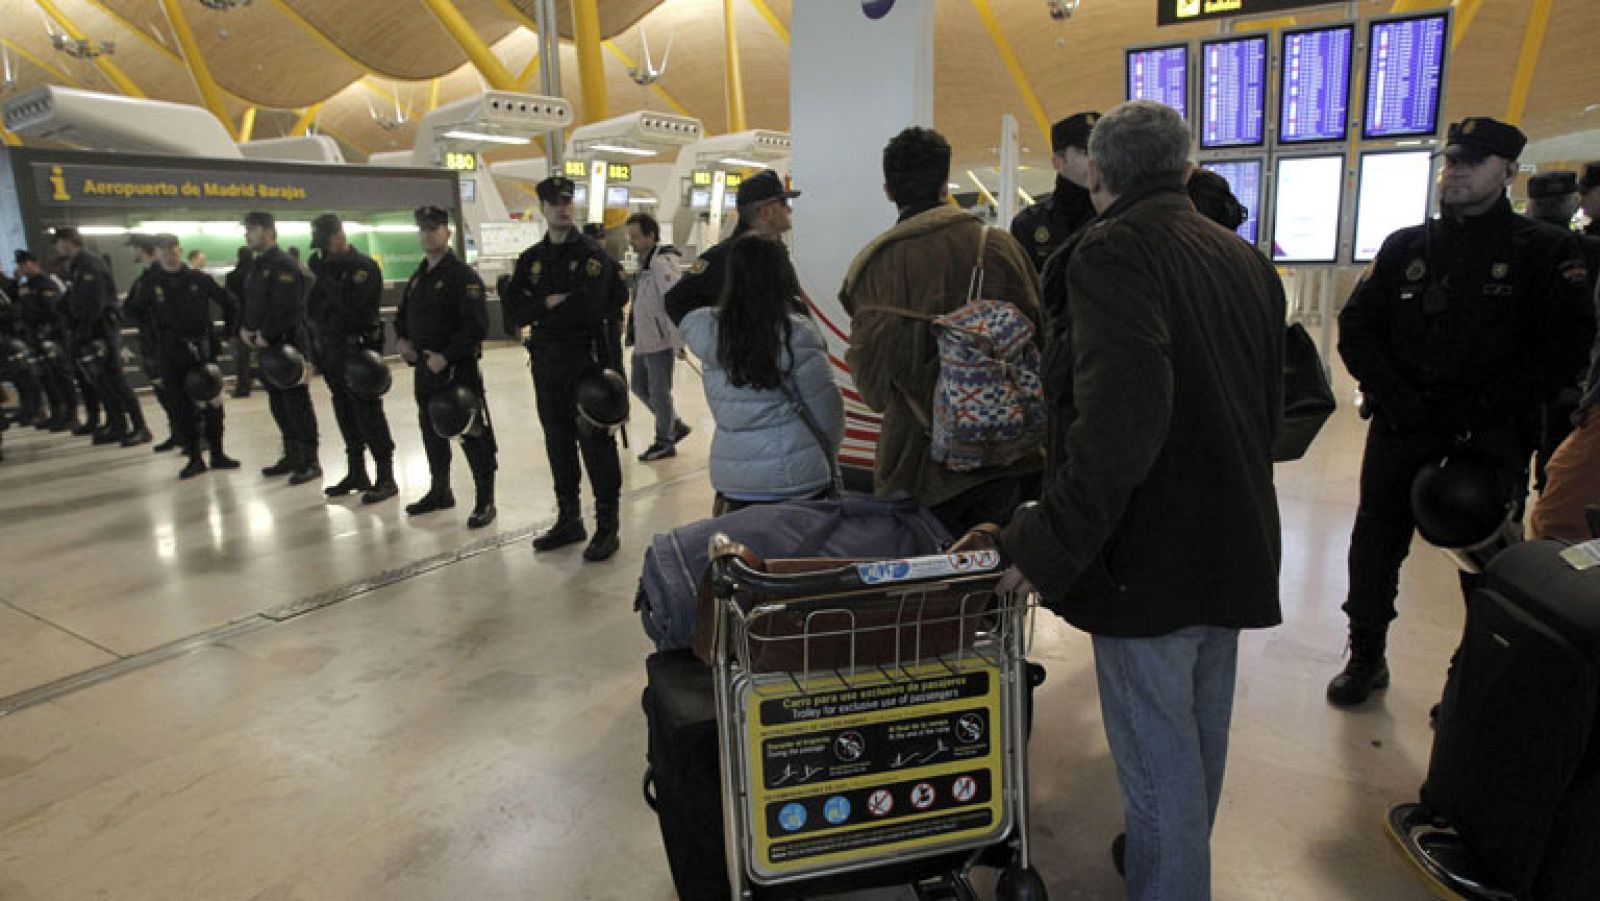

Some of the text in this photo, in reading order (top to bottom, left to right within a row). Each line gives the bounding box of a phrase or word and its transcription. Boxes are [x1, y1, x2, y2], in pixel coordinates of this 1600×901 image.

[446, 152, 474, 170] 880
[564, 161, 586, 176] 881
[609, 164, 629, 179] 882
[83, 179, 177, 197] Aeropuerto
[181, 181, 200, 196] de
[783, 678, 967, 709] Carro para uso exclusivo de pasajeros
[793, 687, 959, 720] Trolley for exclusive use of passengers
